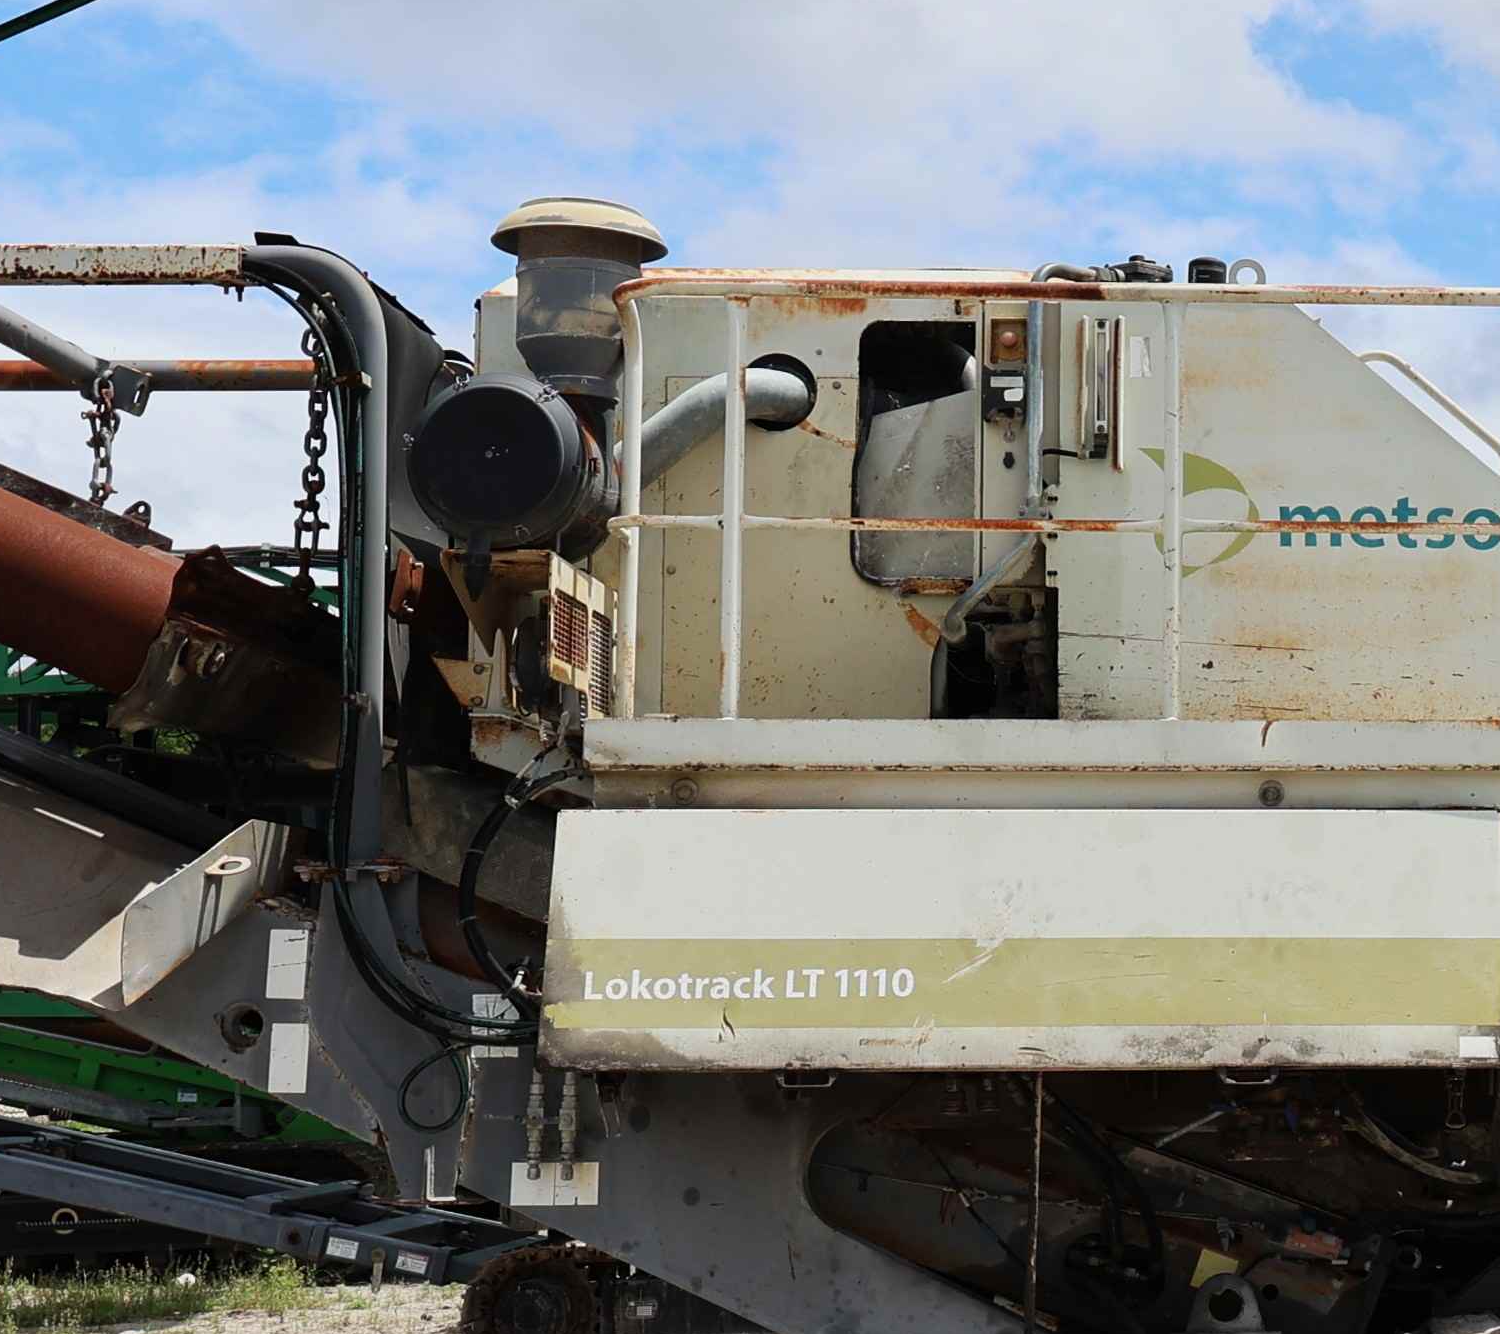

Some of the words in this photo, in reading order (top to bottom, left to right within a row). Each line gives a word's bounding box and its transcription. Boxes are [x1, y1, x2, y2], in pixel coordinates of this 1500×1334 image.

[583, 968, 774, 1001] Lokotrack
[785, 969, 825, 999] LT
[834, 967, 915, 998] 1110
